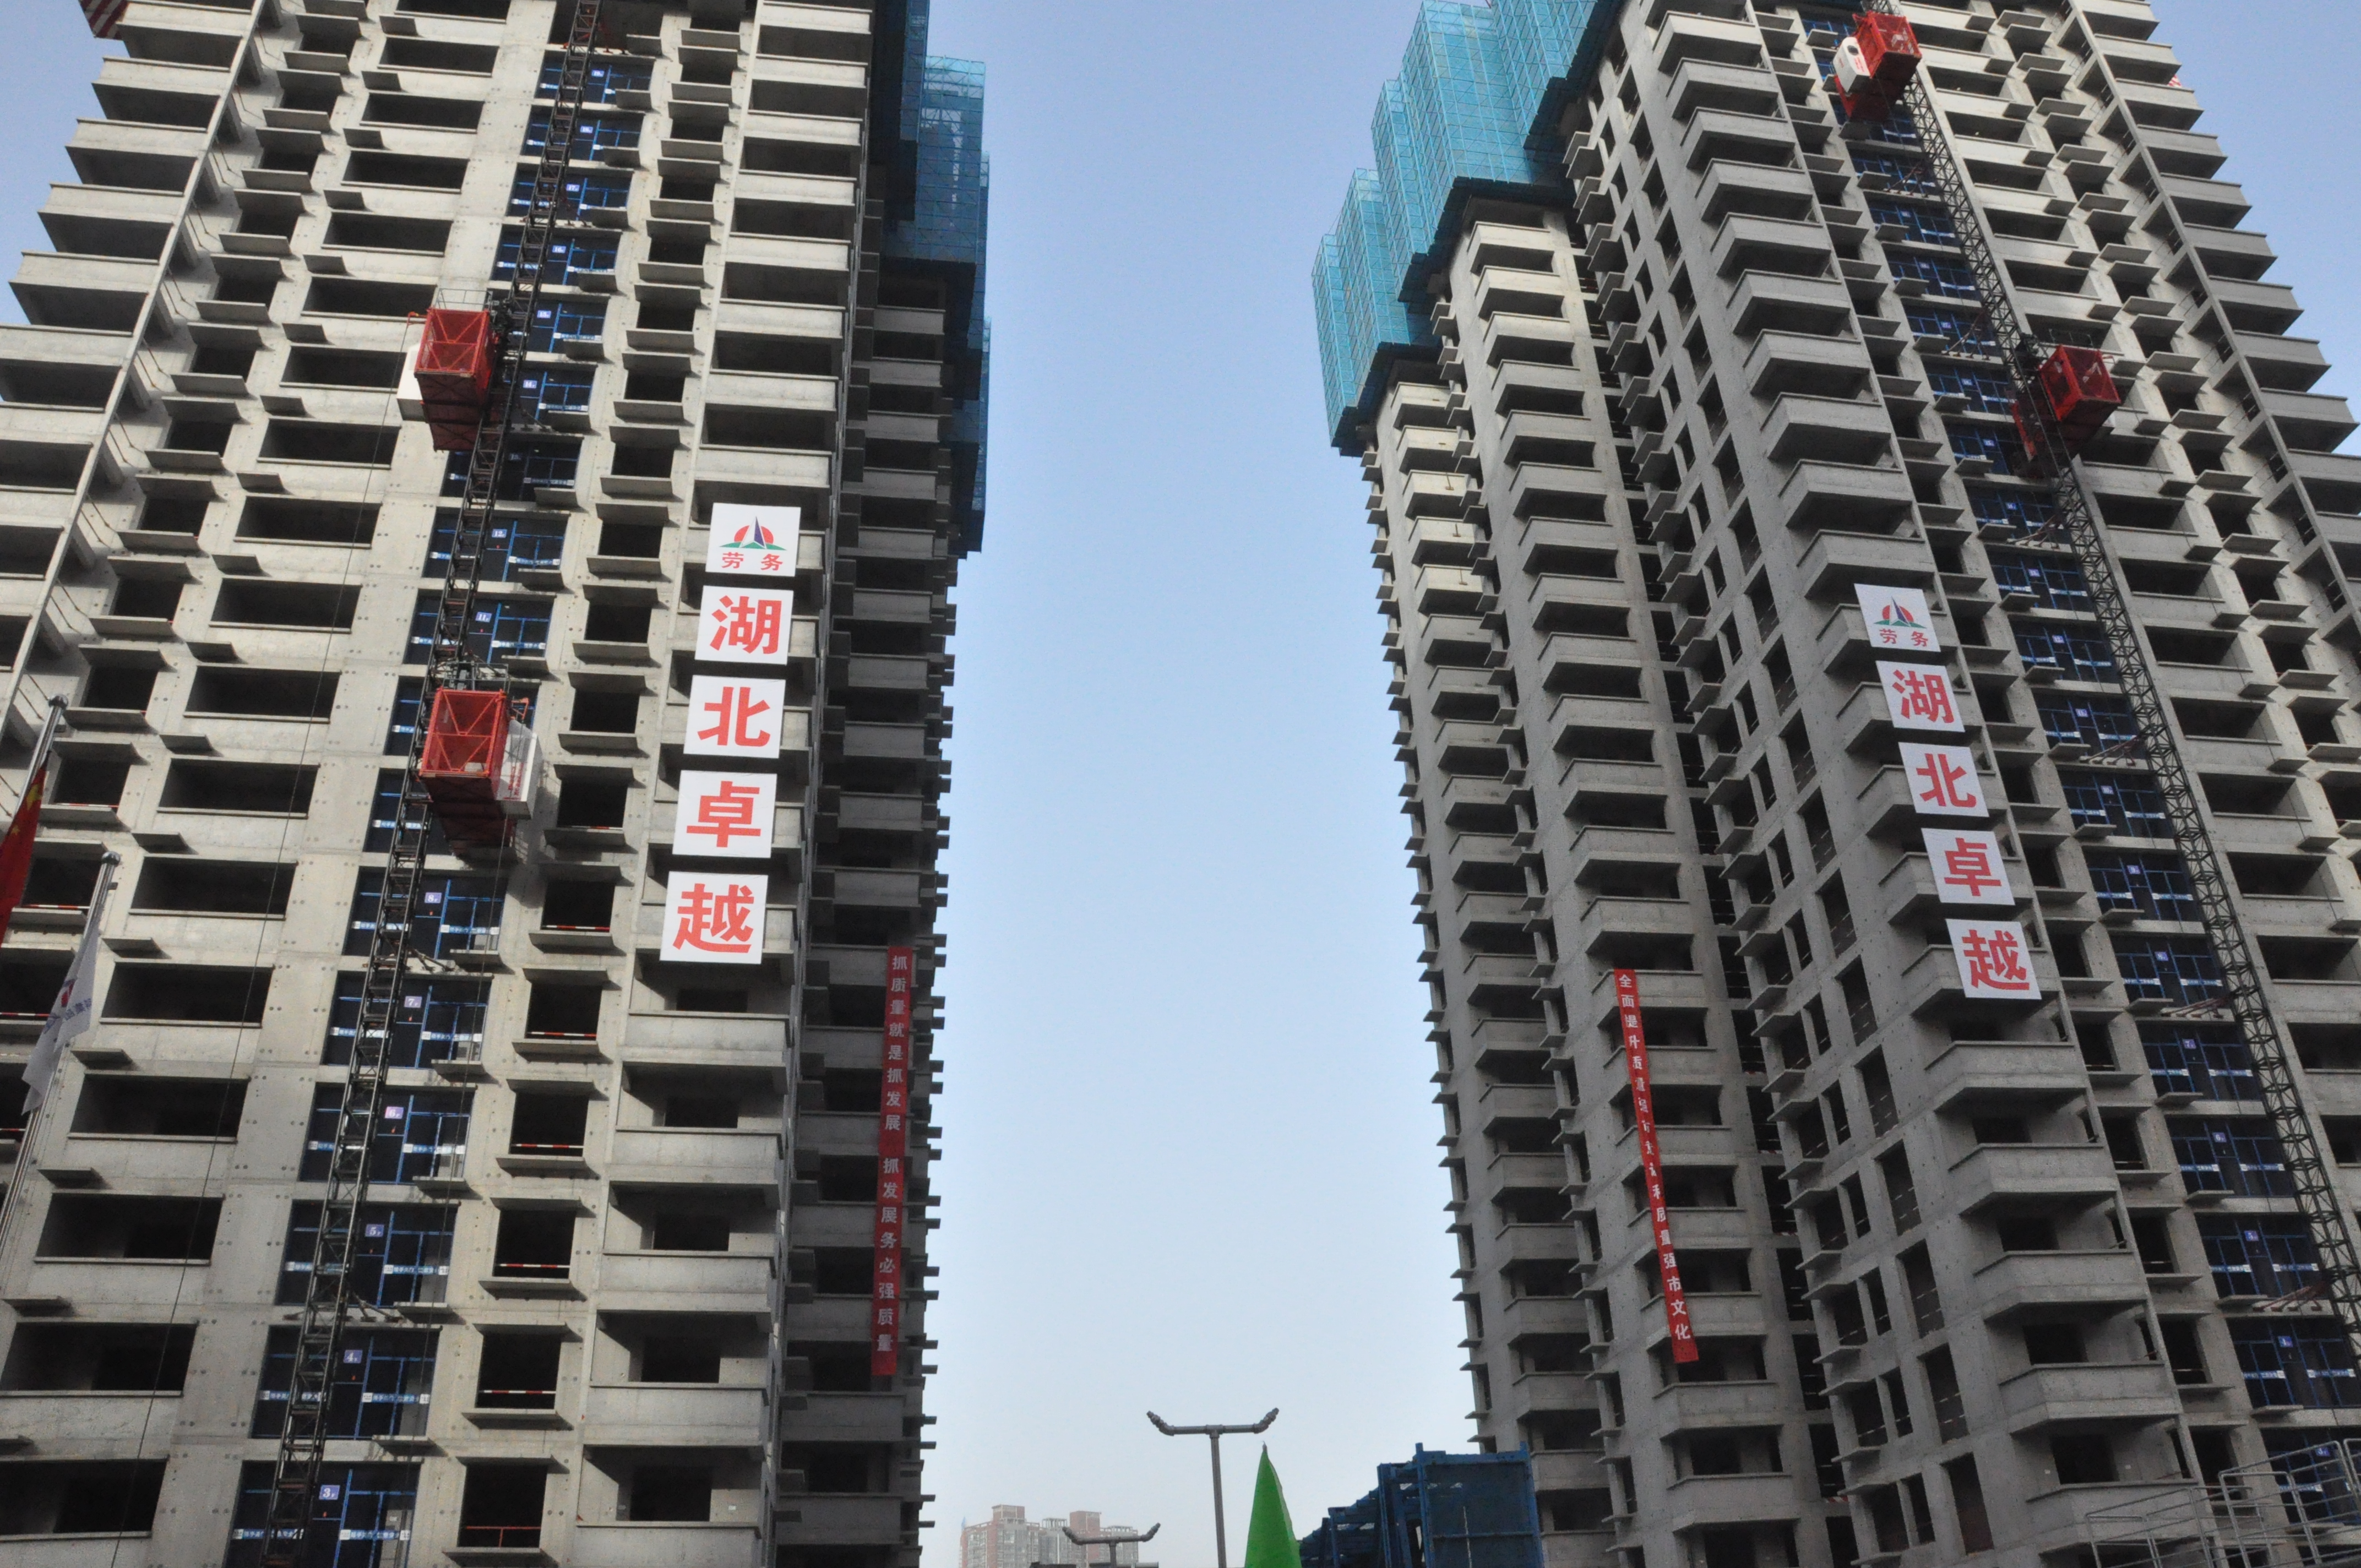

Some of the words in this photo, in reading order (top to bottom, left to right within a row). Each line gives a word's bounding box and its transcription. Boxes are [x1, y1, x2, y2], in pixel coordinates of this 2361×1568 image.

[721, 552, 783, 571] 劳务
[1879, 628, 1928, 647] 劳务
[673, 595, 783, 954] 湖北卓越
[1891, 669, 2030, 992] 湖北卓越
[884, 955, 908, 1131] 抓质量就是抓发展
[877, 1158, 899, 1352] 抓发展务必强质量
